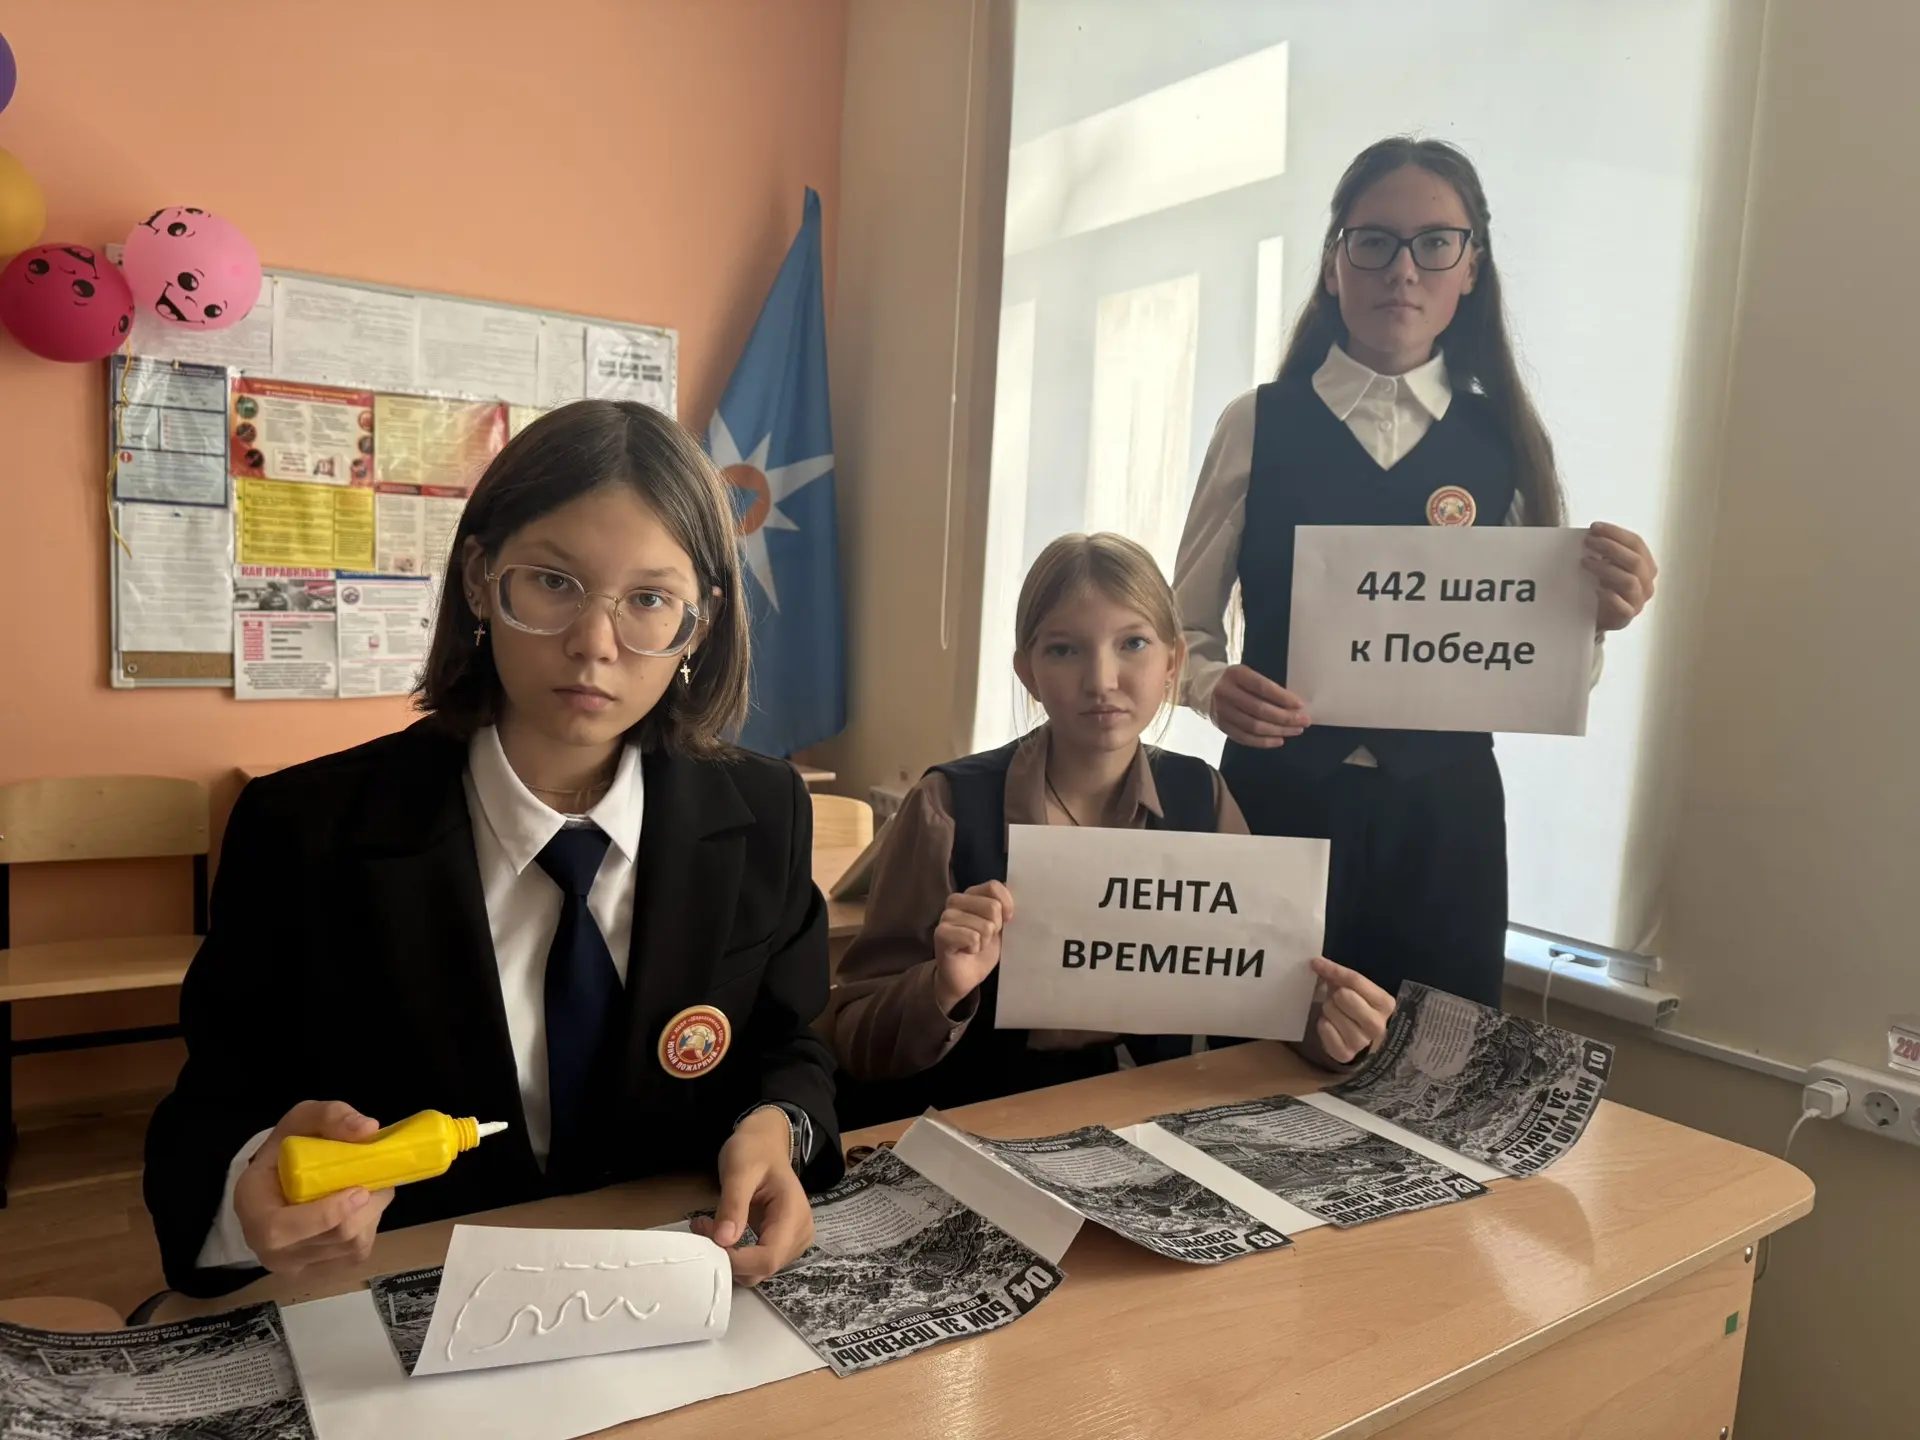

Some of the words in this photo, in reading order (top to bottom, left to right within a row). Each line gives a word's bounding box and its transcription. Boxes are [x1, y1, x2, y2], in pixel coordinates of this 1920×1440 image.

[1357, 571, 1426, 601] 442
[1440, 578, 1537, 602] шага
[1351, 639, 1371, 662] к
[1384, 632, 1535, 671] Победе
[1098, 877, 1238, 914] ЛЕНТА
[1062, 939, 1265, 978] ВРЕМЕНИ
[667, 1040, 679, 1065] ЮНЫЙ
[675, 1051, 718, 1072] ПОЖАРНЫЙ
[1587, 1050, 1607, 1069] 01
[1546, 1087, 1571, 1109] ЗА
[1550, 1076, 1598, 1143] НАЧАЛО
[1504, 1111, 1560, 1159] КАВКАЗ
[1510, 1142, 1562, 1178] БИТВЫ
[823, 1190, 837, 1200] не
[838, 1178, 868, 1198] Горы
[1379, 1176, 1438, 1198] ЗНАЧЕНИЕ
[1453, 1177, 1481, 1193] 02
[1313, 1191, 1379, 1216] КАВКАЗА
[1334, 1186, 1452, 1223] СТРАТЕГИЧЕСКОЕ
[1250, 1231, 1283, 1247] 03
[1012, 1265, 1053, 1302] 04
[946, 1297, 982, 1315] АВГУСТ
[961, 1299, 1010, 1328] БОИ
[185, 1319, 230, 1335] Победа
[865, 1323, 888, 1338] 1942
[891, 1312, 931, 1328] НОЯБРЬ
[937, 1312, 966, 1333] ЗА
[74, 1333, 159, 1347] Сталинградом
[93, 1323, 180, 1341] освобождению
[161, 1329, 184, 1339] под
[835, 1331, 864, 1346] ГОДА
[831, 1320, 939, 1367] ПЕРЕВАЛЫ
